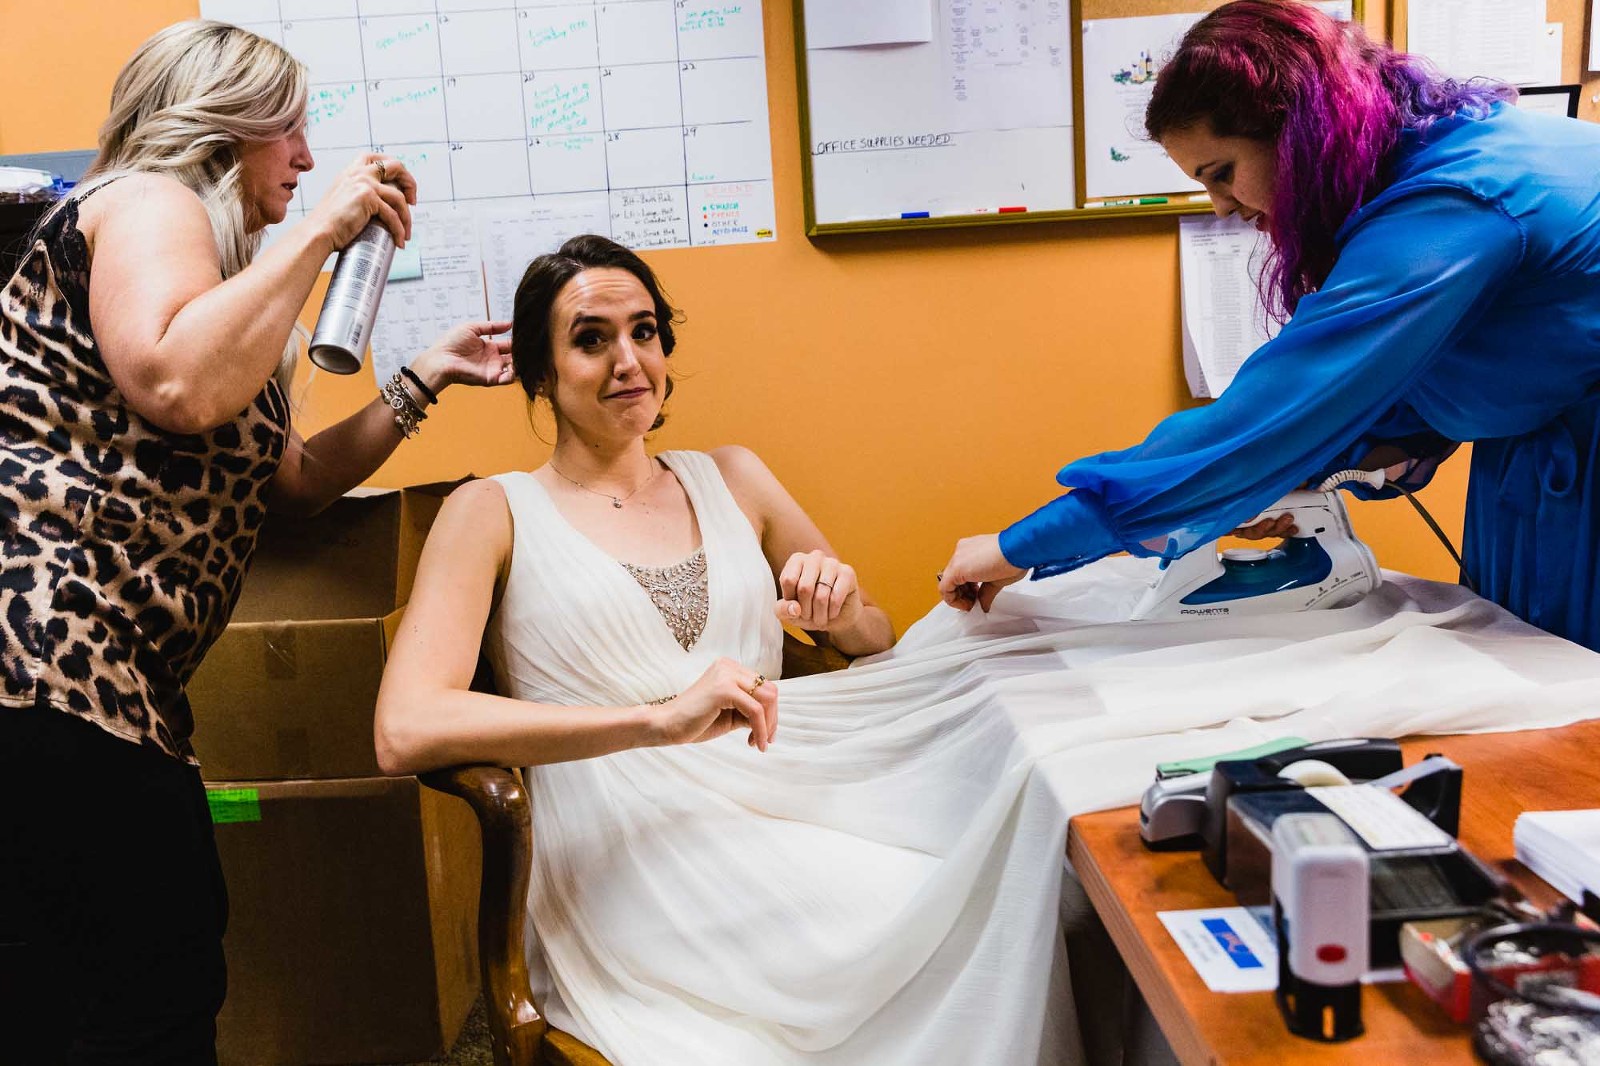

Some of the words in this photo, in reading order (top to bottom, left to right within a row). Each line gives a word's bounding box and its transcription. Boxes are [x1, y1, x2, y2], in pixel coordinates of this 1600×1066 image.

[816, 140, 857, 155] OFFICE
[860, 136, 904, 149] SUPPLIES
[908, 133, 951, 147] NEEDED
